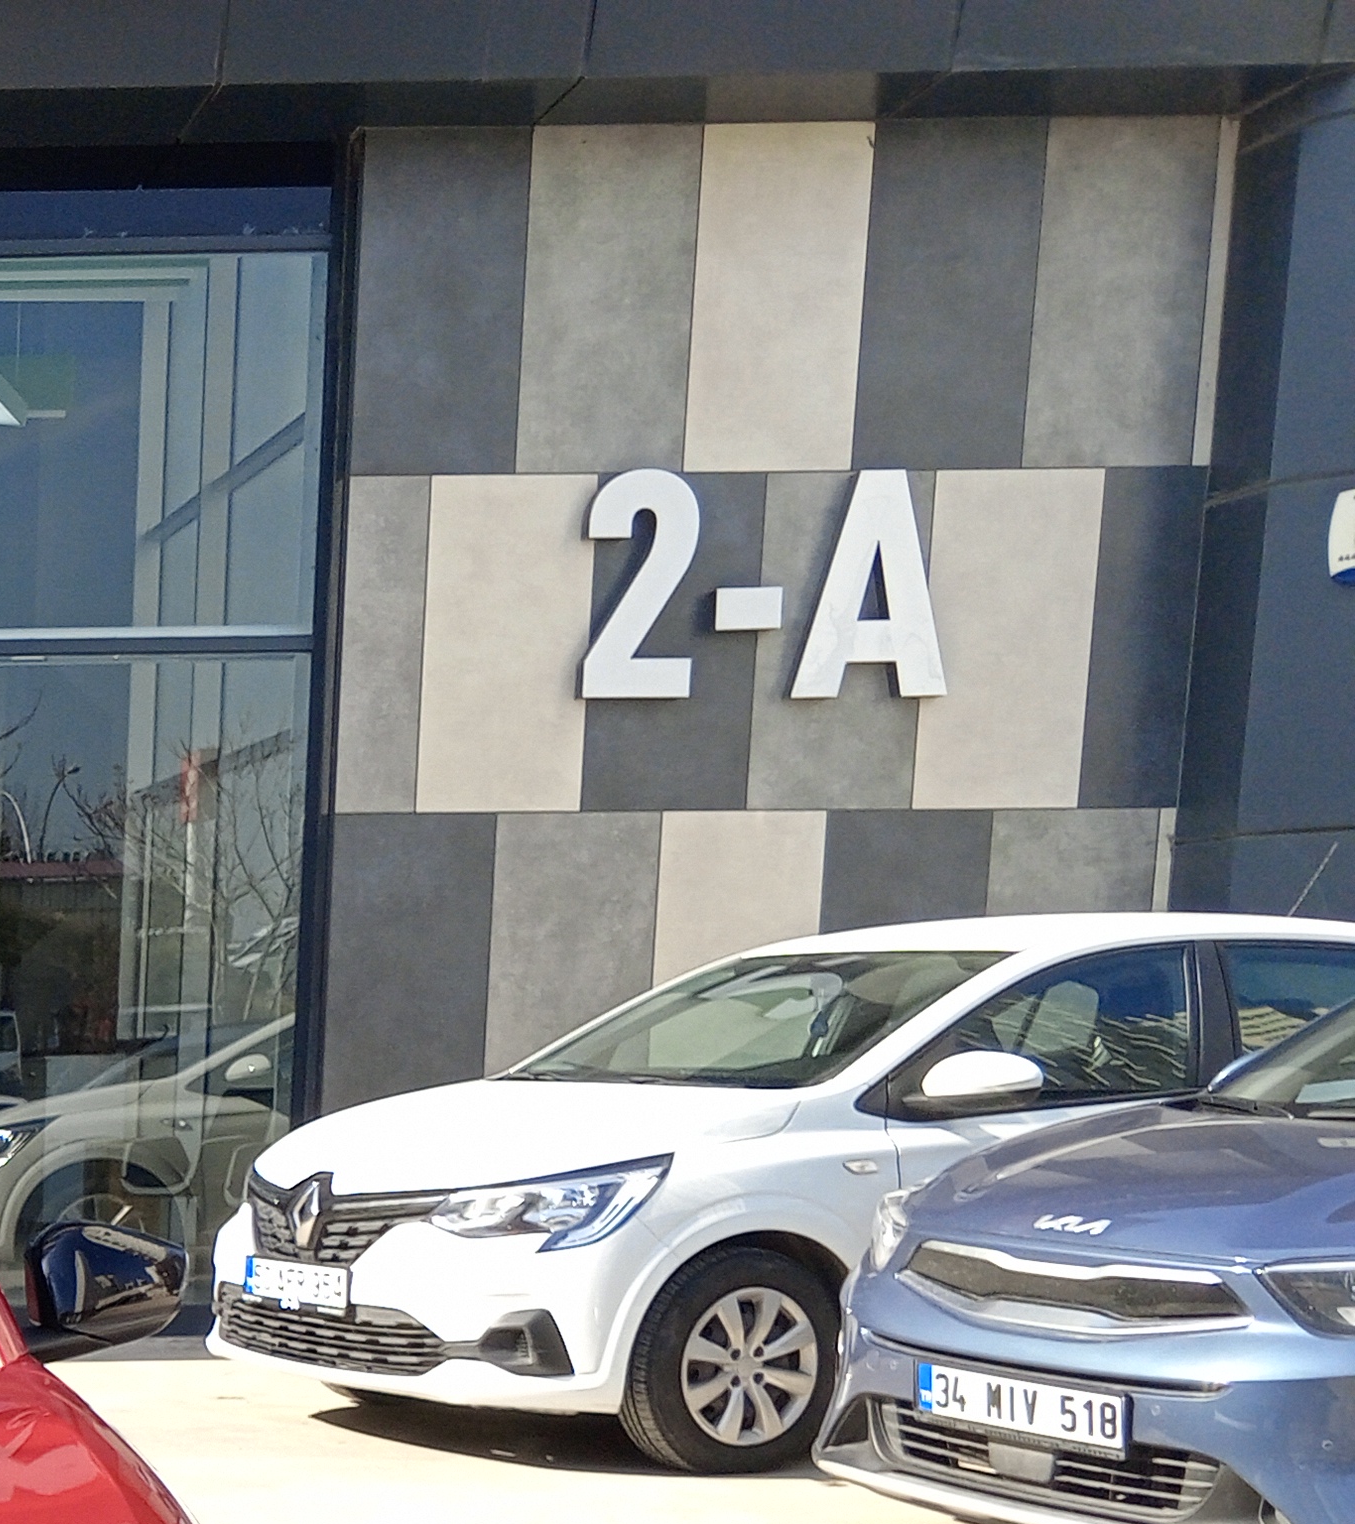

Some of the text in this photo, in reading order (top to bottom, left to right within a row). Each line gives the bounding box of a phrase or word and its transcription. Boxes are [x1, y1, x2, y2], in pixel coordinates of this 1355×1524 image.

[578, 467, 948, 700] 2-A
[935, 1373, 967, 1413] 34
[986, 1382, 1038, 1425] MIV
[1059, 1394, 1118, 1440] 518
